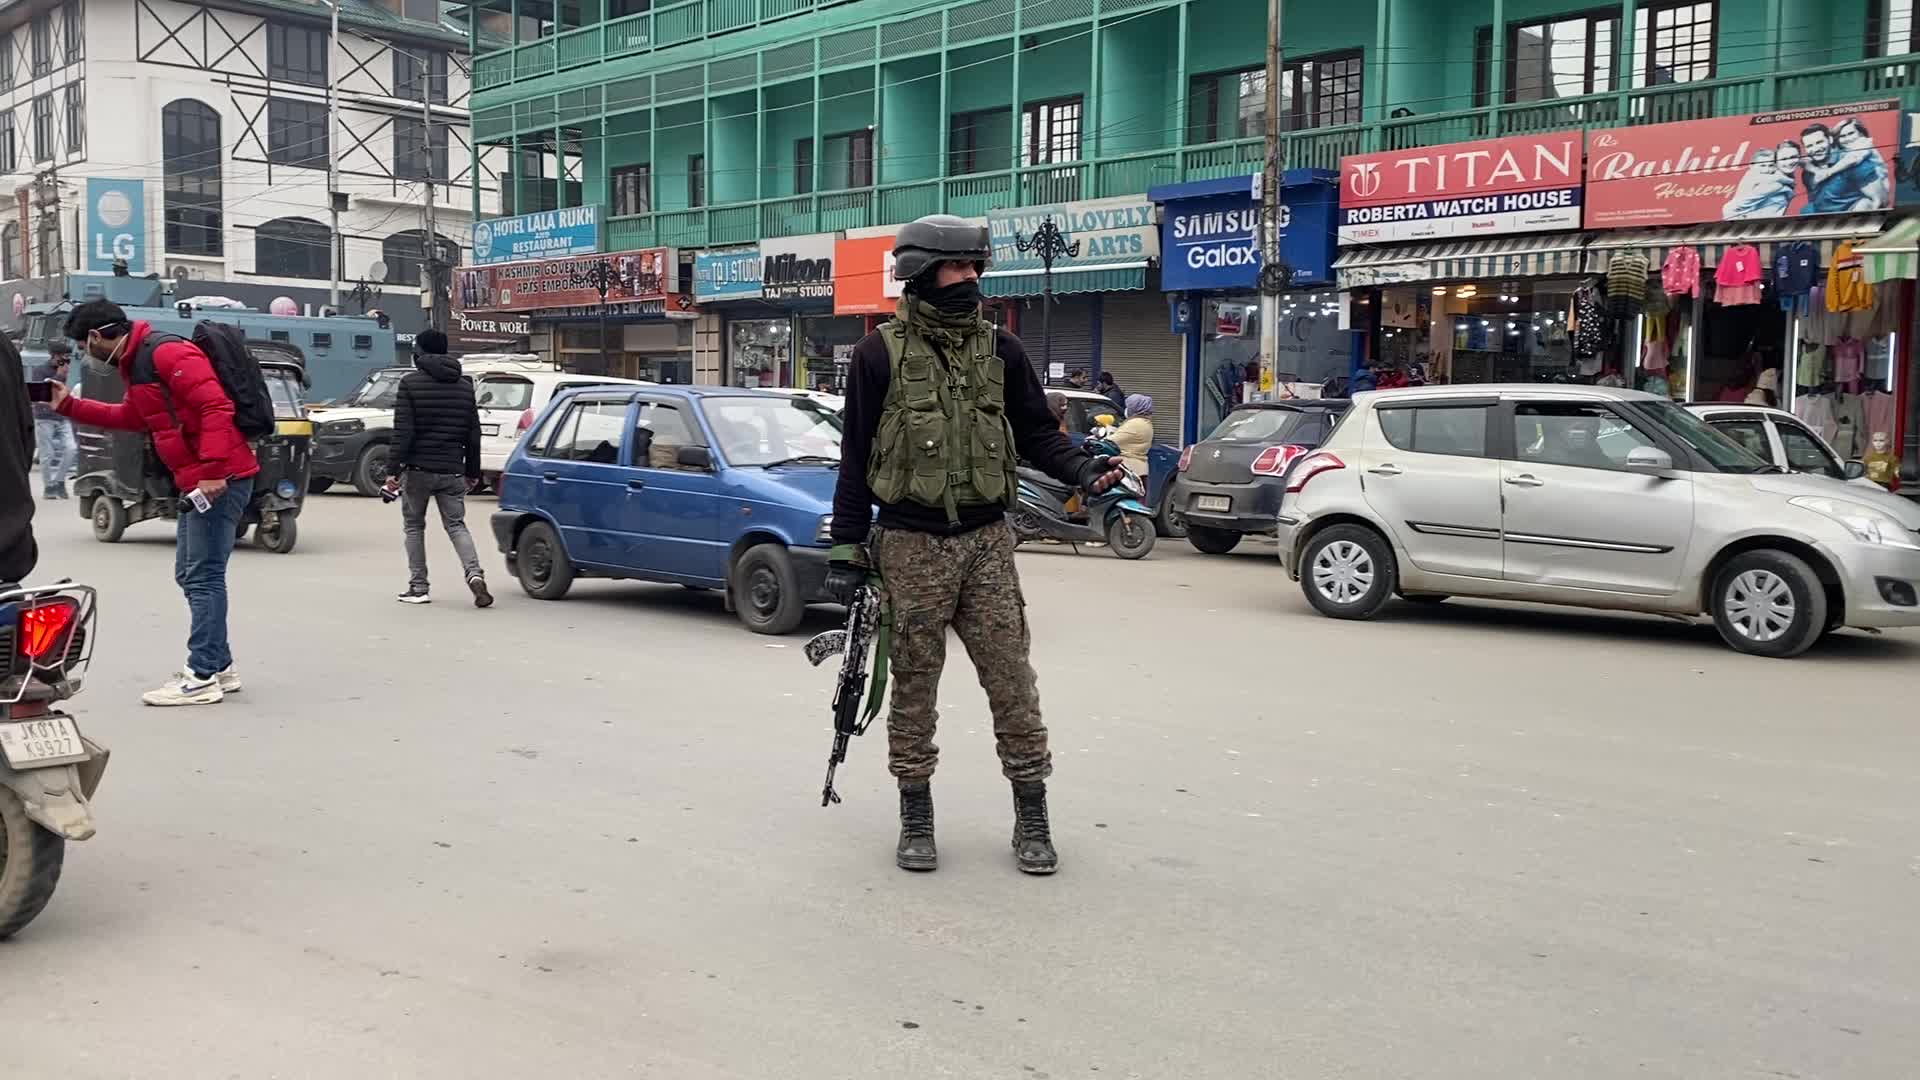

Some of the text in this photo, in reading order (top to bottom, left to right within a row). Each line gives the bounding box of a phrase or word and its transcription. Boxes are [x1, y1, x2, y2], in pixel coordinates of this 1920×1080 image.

[1394, 140, 1574, 193] TITAN
[1592, 141, 1750, 180] Rashid
[1653, 182, 1736, 200] Hosiery
[1070, 206, 1153, 232] LOVELY
[1347, 190, 1572, 224] ROBERTA WATCH HOUSE
[493, 207, 594, 237] HOTEL LALA RUKH
[990, 218, 1013, 238] DIL
[1174, 205, 1290, 238] SAMSUG
[95, 233, 135, 260] LG
[512, 237, 573, 253] RESTAURANT
[1087, 233, 1142, 257] ARTS
[1187, 243, 1265, 272] Galax
[497, 262, 540, 280] KASHMIR
[764, 253, 831, 284] Nikon
[765, 287, 781, 299] TAJ
[800, 285, 833, 297] STUDIO
[460, 319, 496, 333] POWER
[20, 720, 69, 740] JK01A
